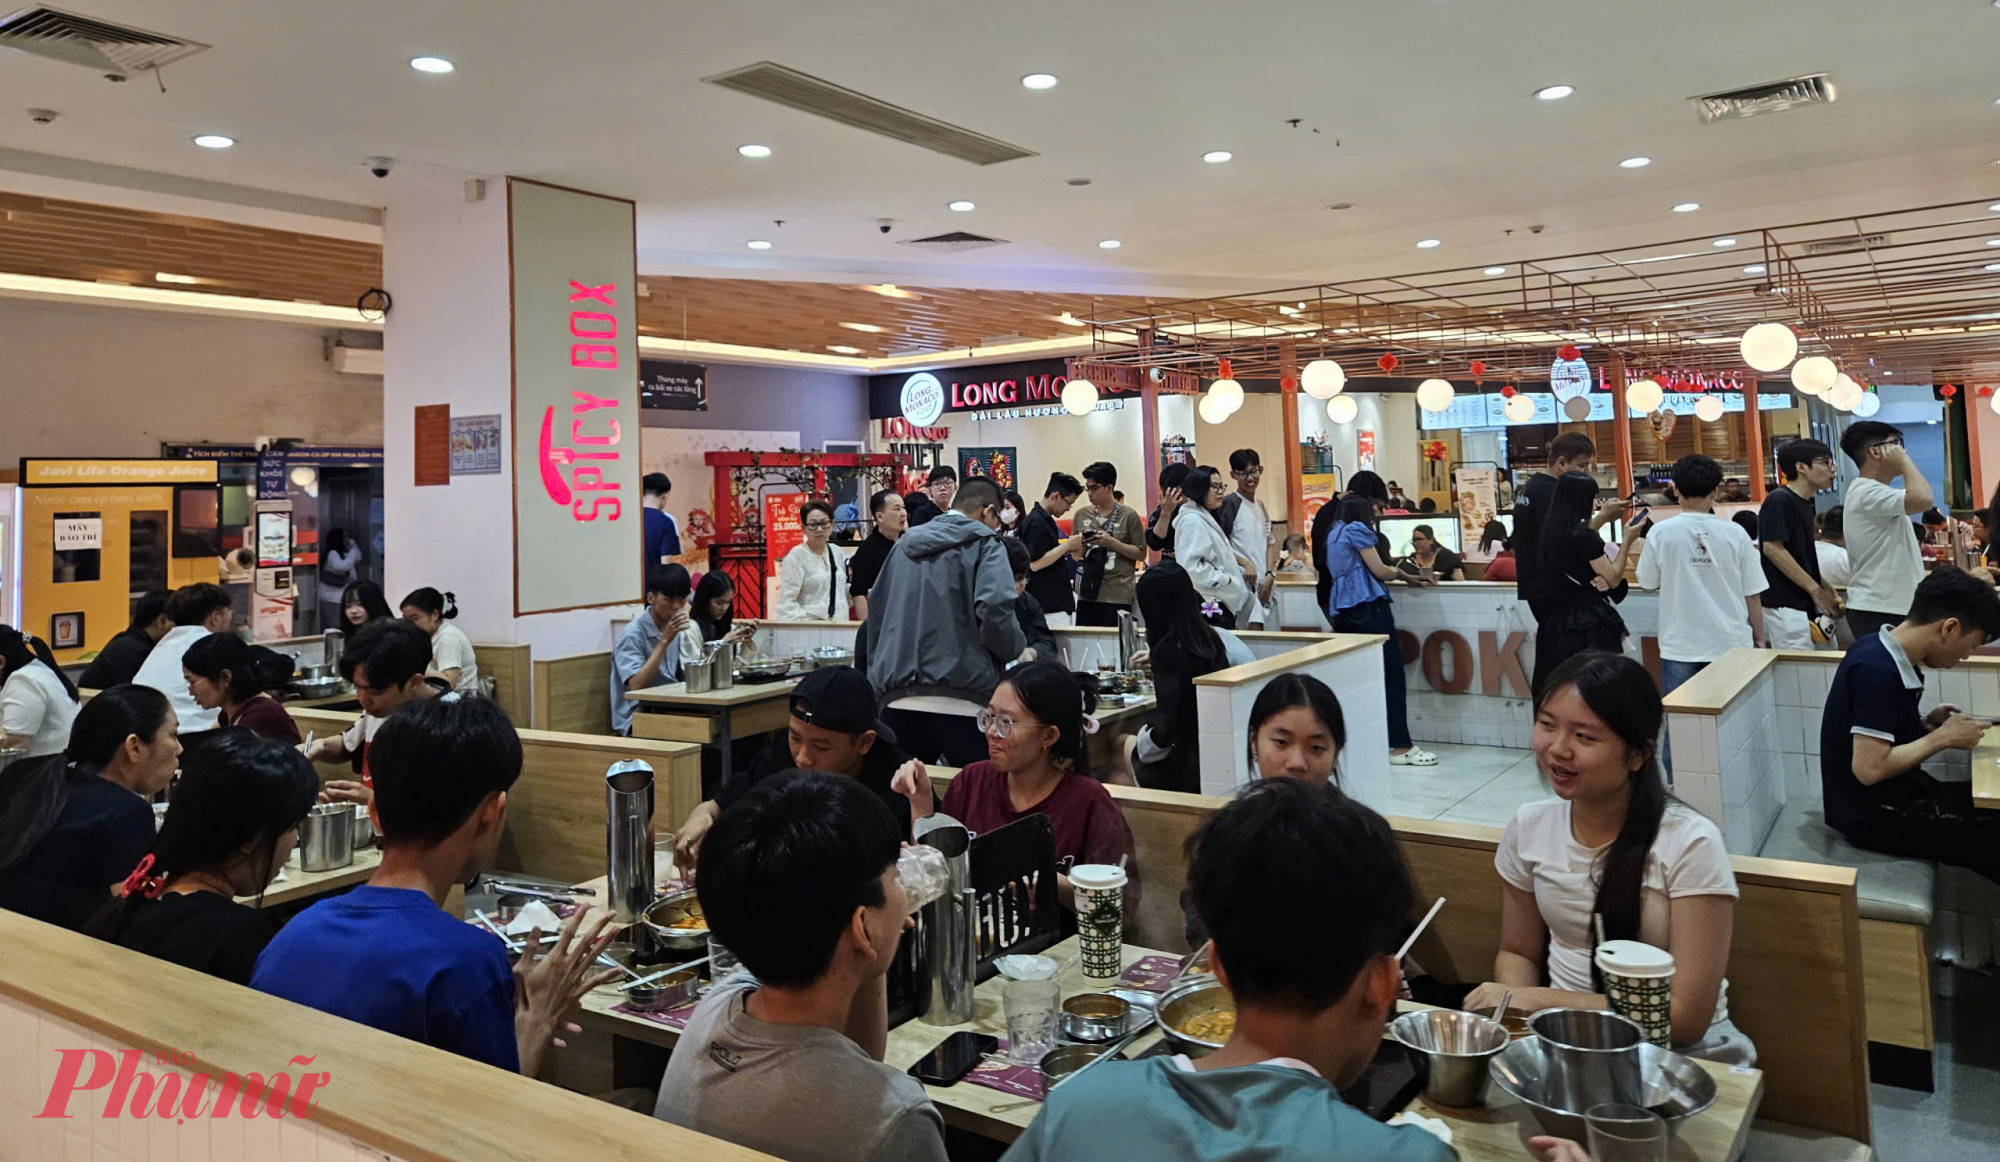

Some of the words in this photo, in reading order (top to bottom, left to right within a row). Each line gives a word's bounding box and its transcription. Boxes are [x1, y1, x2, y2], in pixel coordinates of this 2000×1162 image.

[570, 279, 619, 370] BOX
[951, 380, 1017, 408] LONG
[39, 465, 73, 476] Javi
[77, 465, 106, 476] Life
[111, 466, 164, 478] Orange
[168, 464, 208, 476] Juice
[571, 391, 621, 522] SPICY
